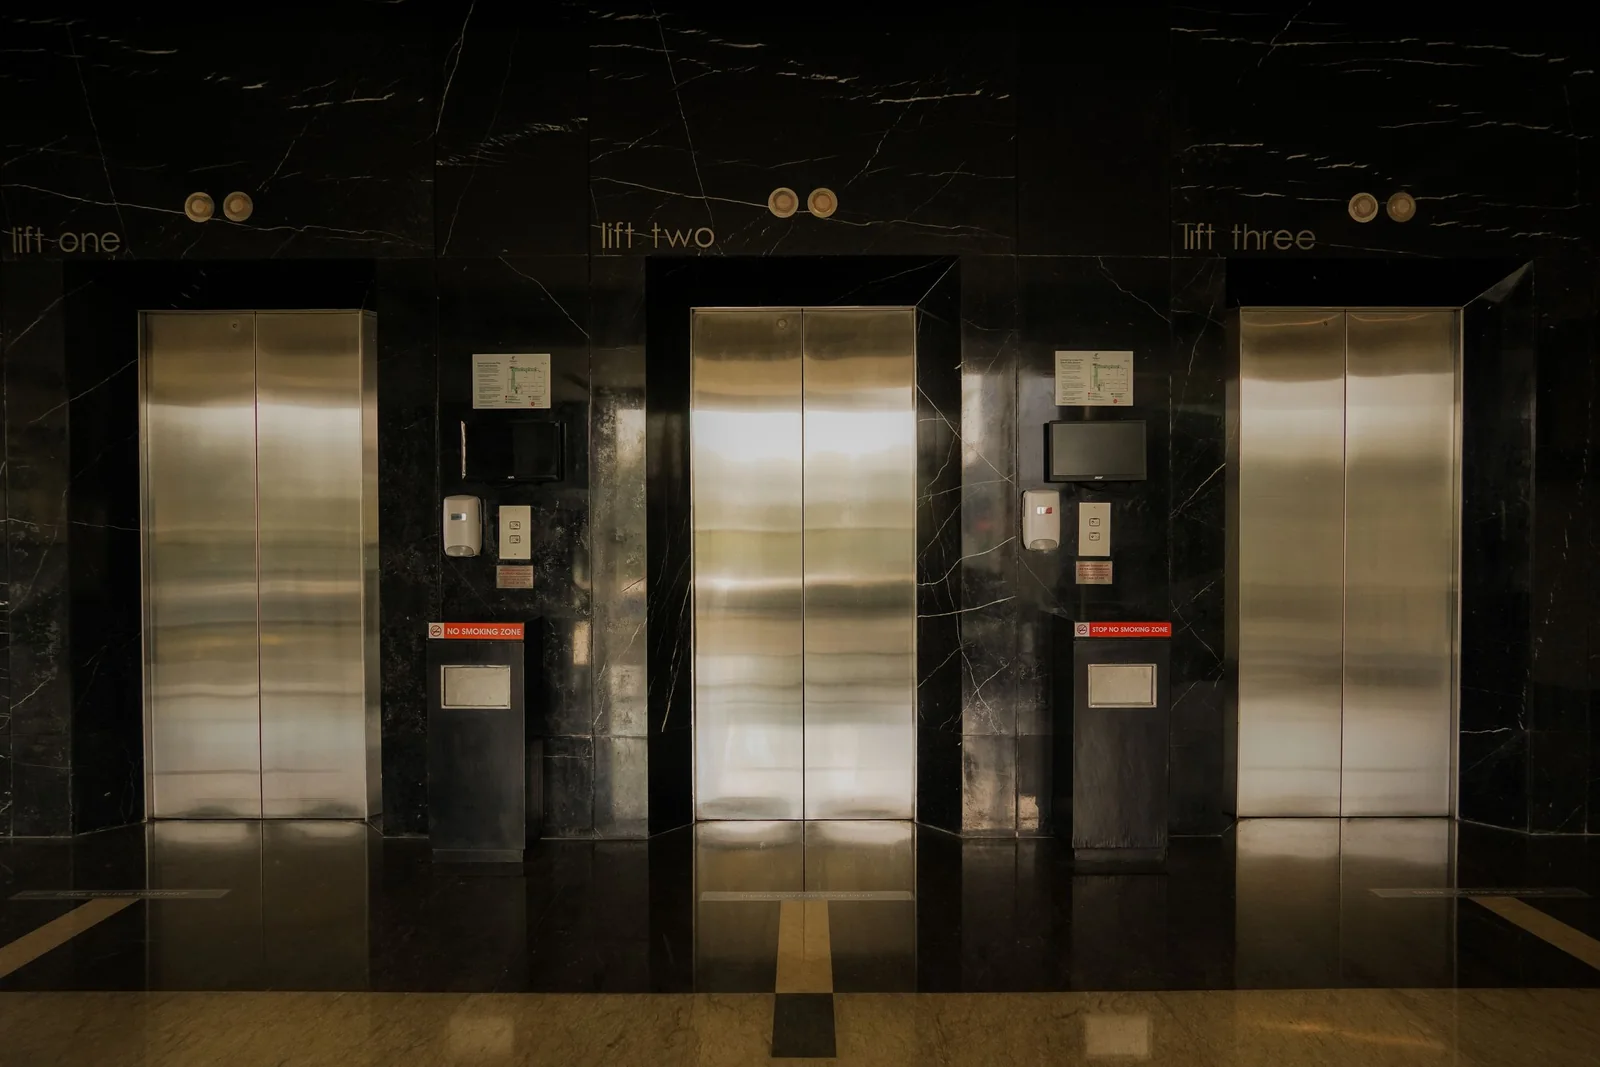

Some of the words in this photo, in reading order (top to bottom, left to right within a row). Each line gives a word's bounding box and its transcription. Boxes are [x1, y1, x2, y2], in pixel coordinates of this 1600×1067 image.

[12, 226, 45, 253] lift
[60, 232, 121, 253] one
[602, 222, 635, 249] lift
[651, 222, 715, 249] two
[1184, 222, 1216, 250] lift
[1231, 223, 1316, 250] three
[447, 627, 460, 635] NO
[461, 627, 499, 636] SMOKING
[500, 628, 521, 636] ZONE
